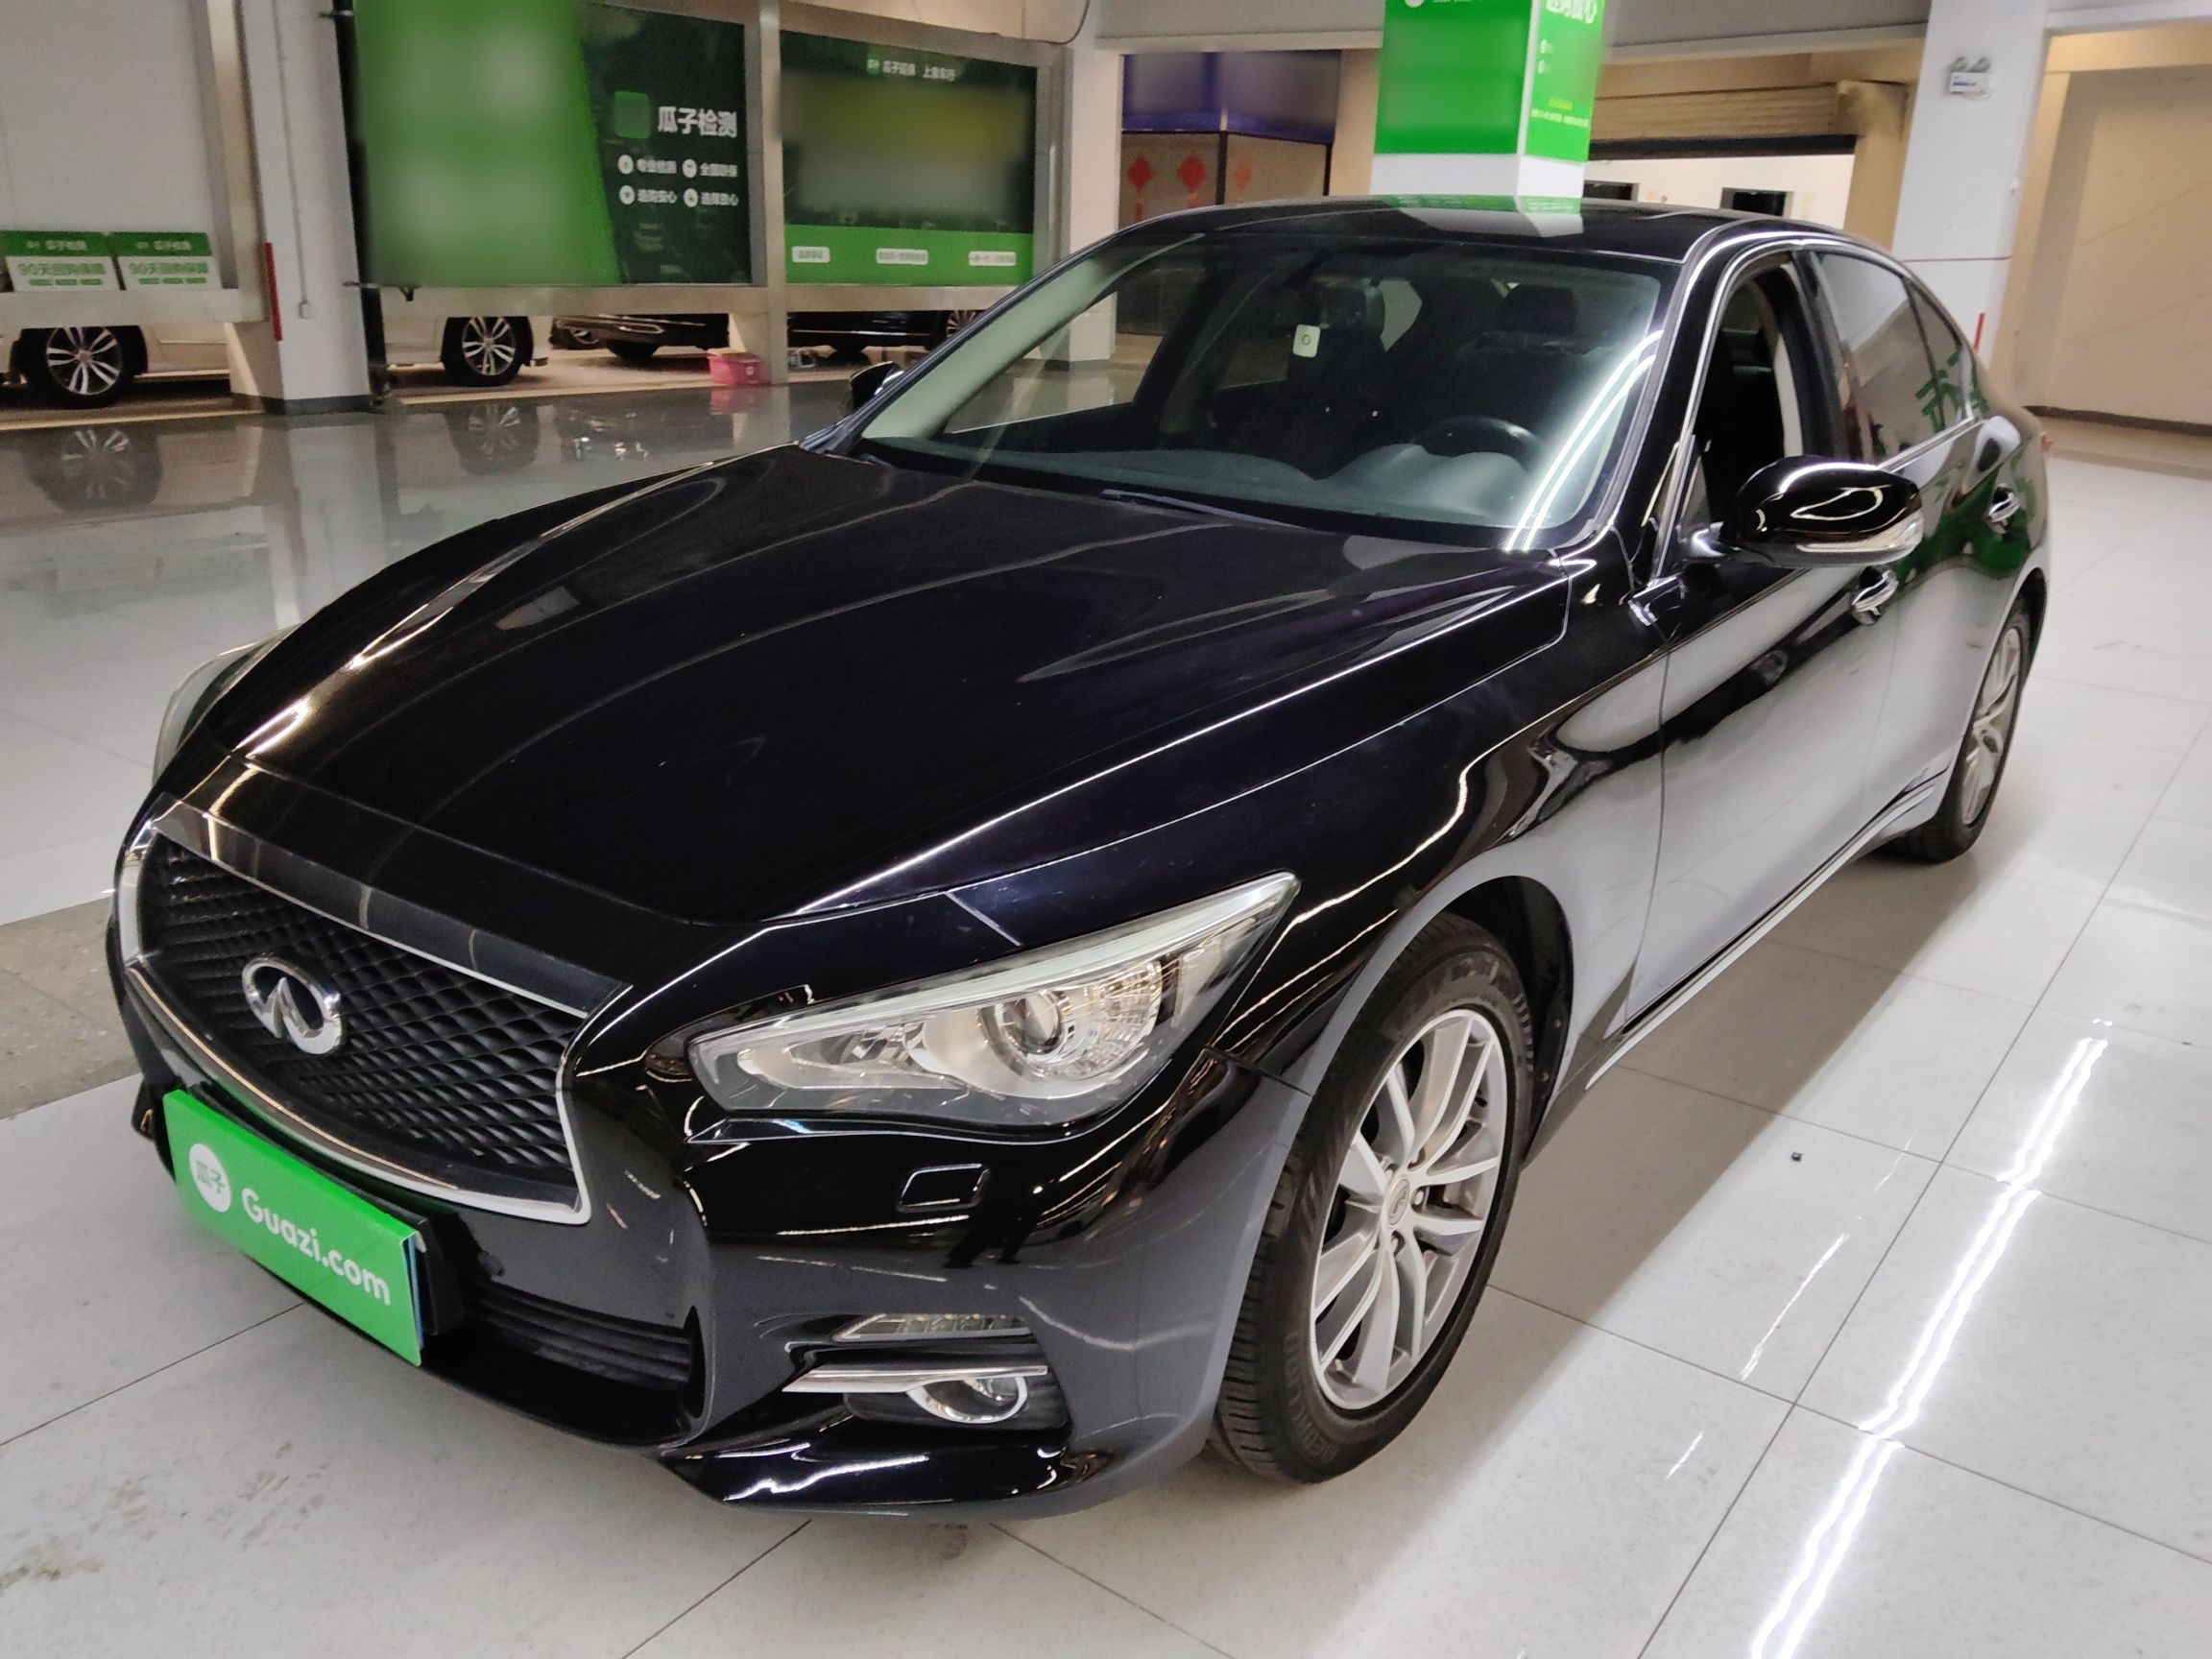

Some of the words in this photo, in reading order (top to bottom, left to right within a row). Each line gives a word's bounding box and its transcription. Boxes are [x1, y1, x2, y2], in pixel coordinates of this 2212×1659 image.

[658, 106, 737, 137] 瓜子检测
[241, 1188, 392, 1307] Guazi.com
